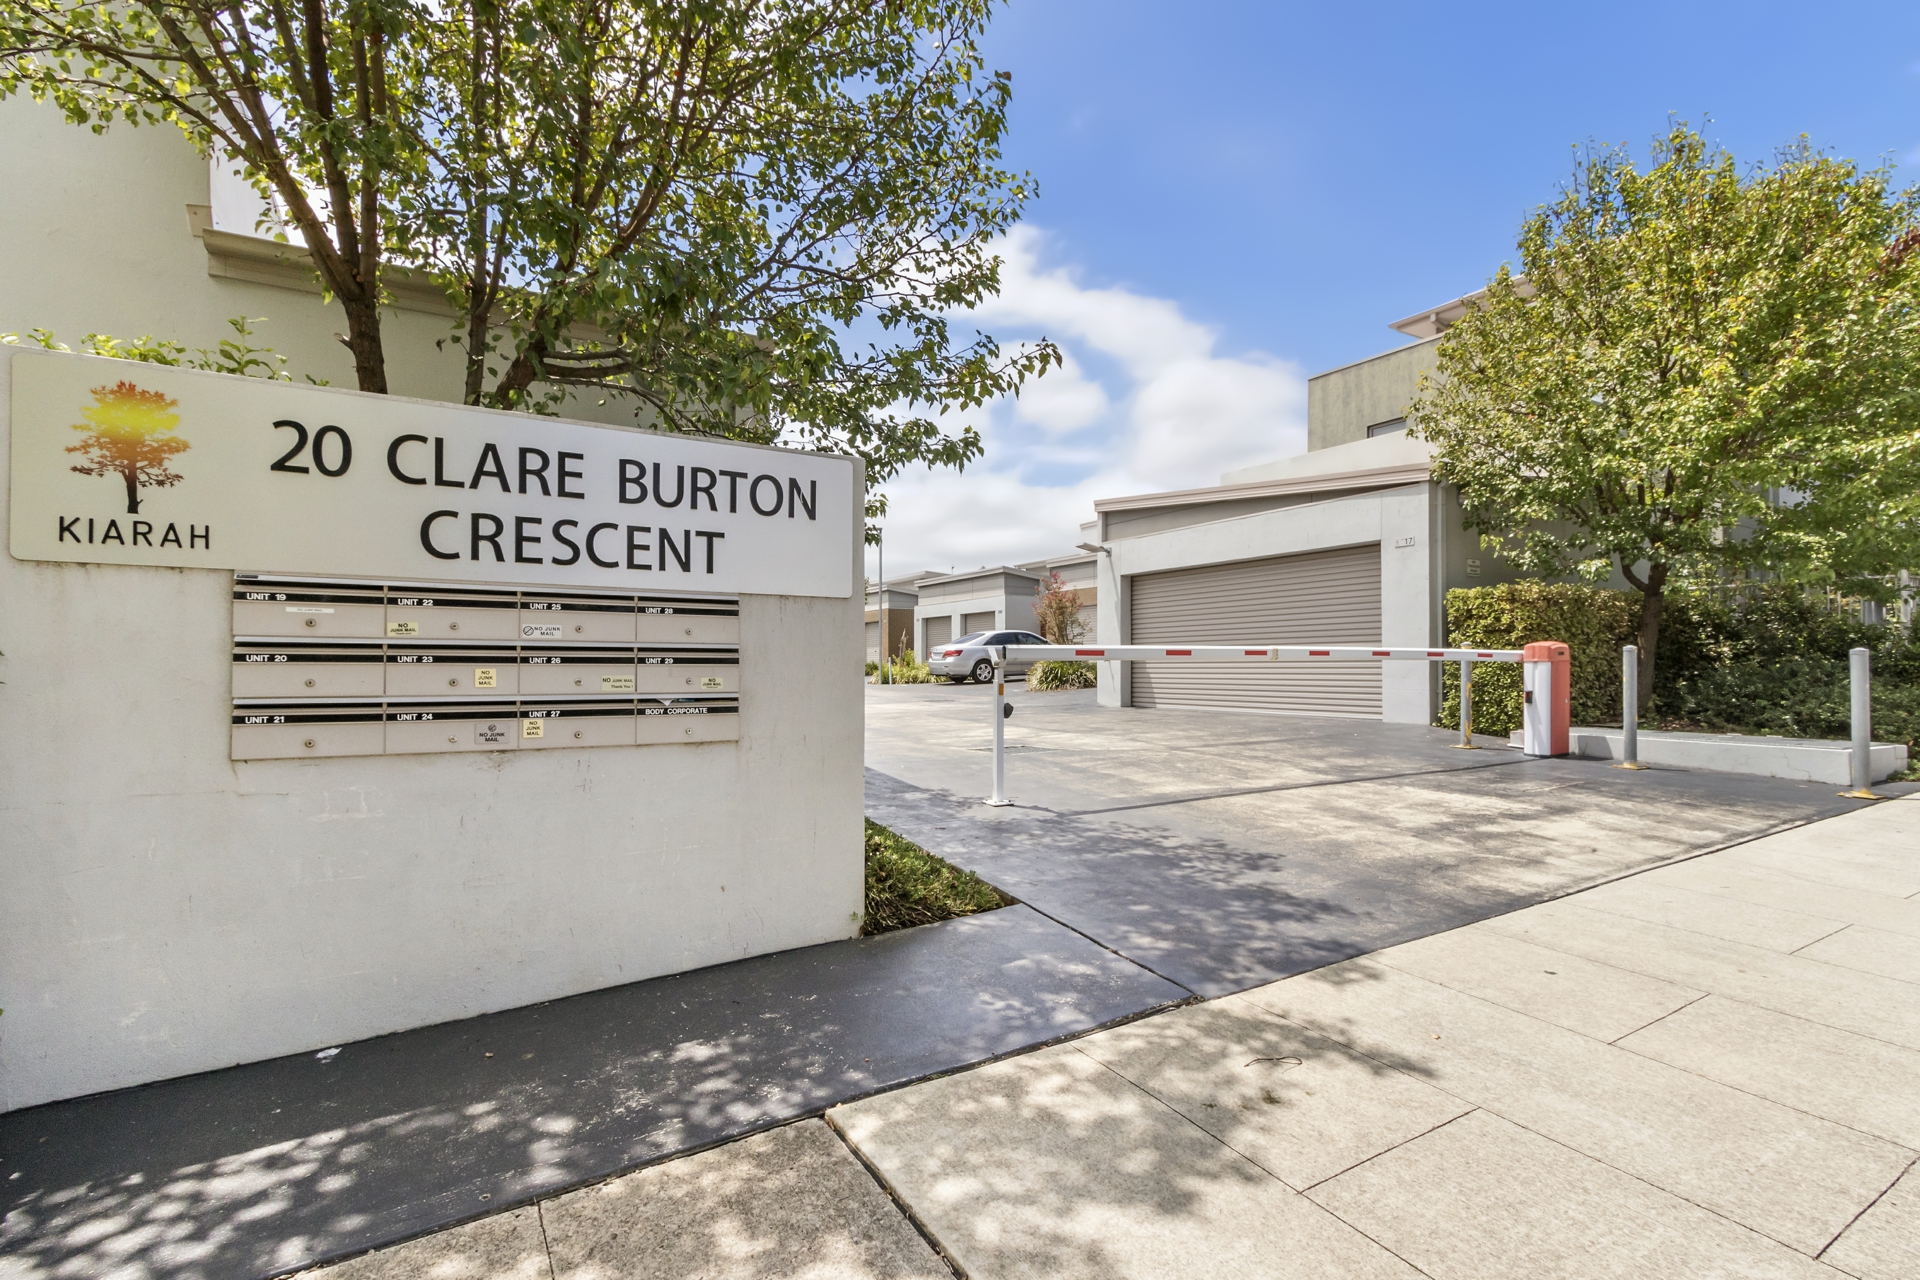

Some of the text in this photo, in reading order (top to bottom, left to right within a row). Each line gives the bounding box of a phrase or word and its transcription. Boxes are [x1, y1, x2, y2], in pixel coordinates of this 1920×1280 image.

[270, 419, 817, 521] 20 CLARE BURTON
[58, 516, 210, 550] KIARAH
[420, 509, 725, 574] CRESCENT
